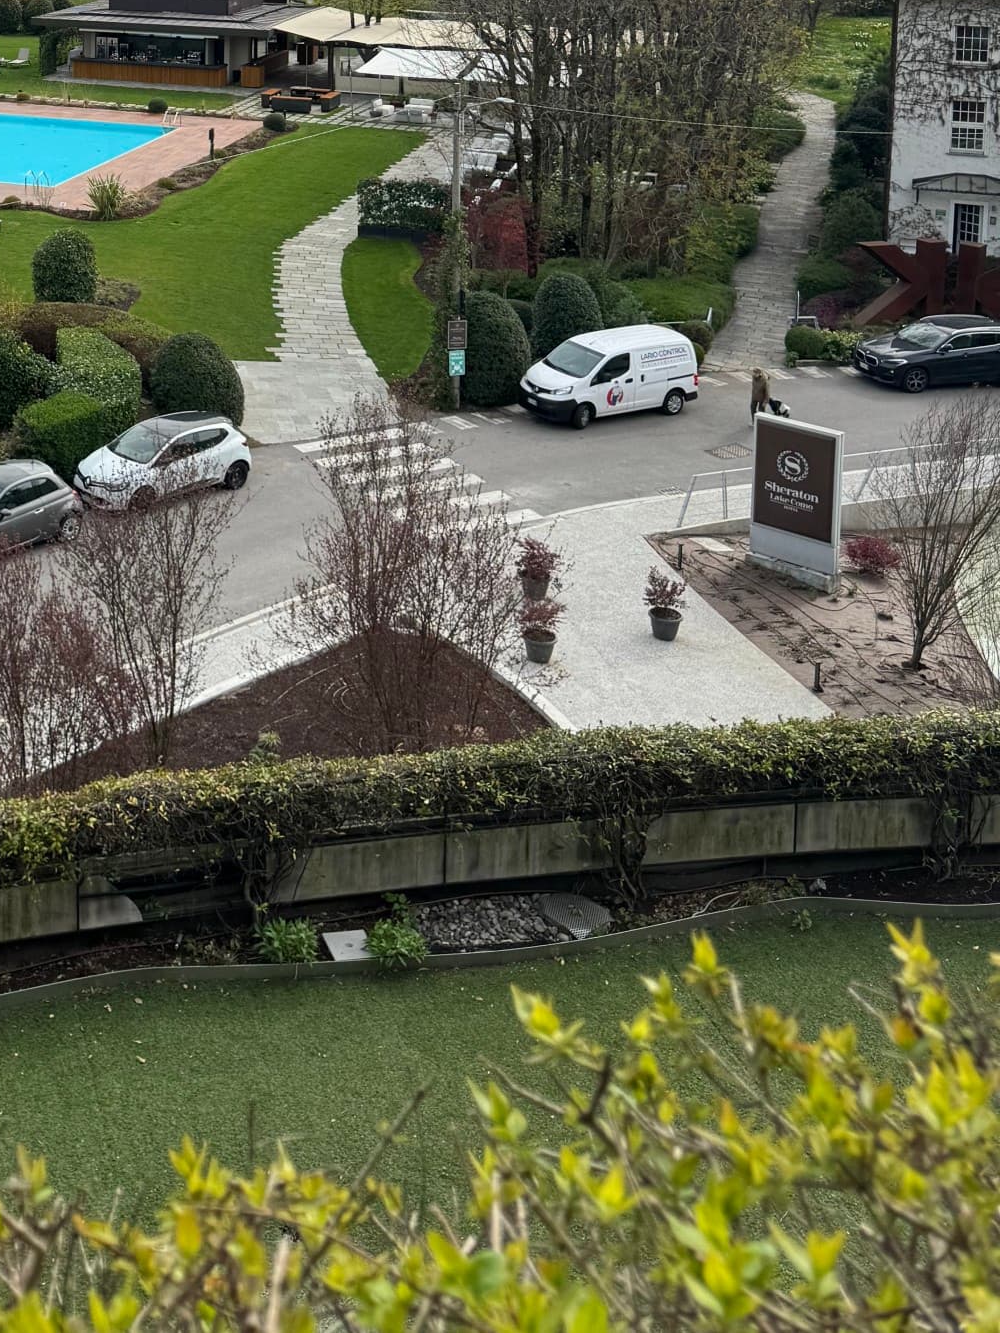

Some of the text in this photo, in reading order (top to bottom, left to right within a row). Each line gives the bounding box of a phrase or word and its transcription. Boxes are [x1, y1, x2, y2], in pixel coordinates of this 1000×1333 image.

[784, 455, 801, 475] S
[764, 480, 819, 504] Sheraton
[769, 492, 814, 511] Lake Como
